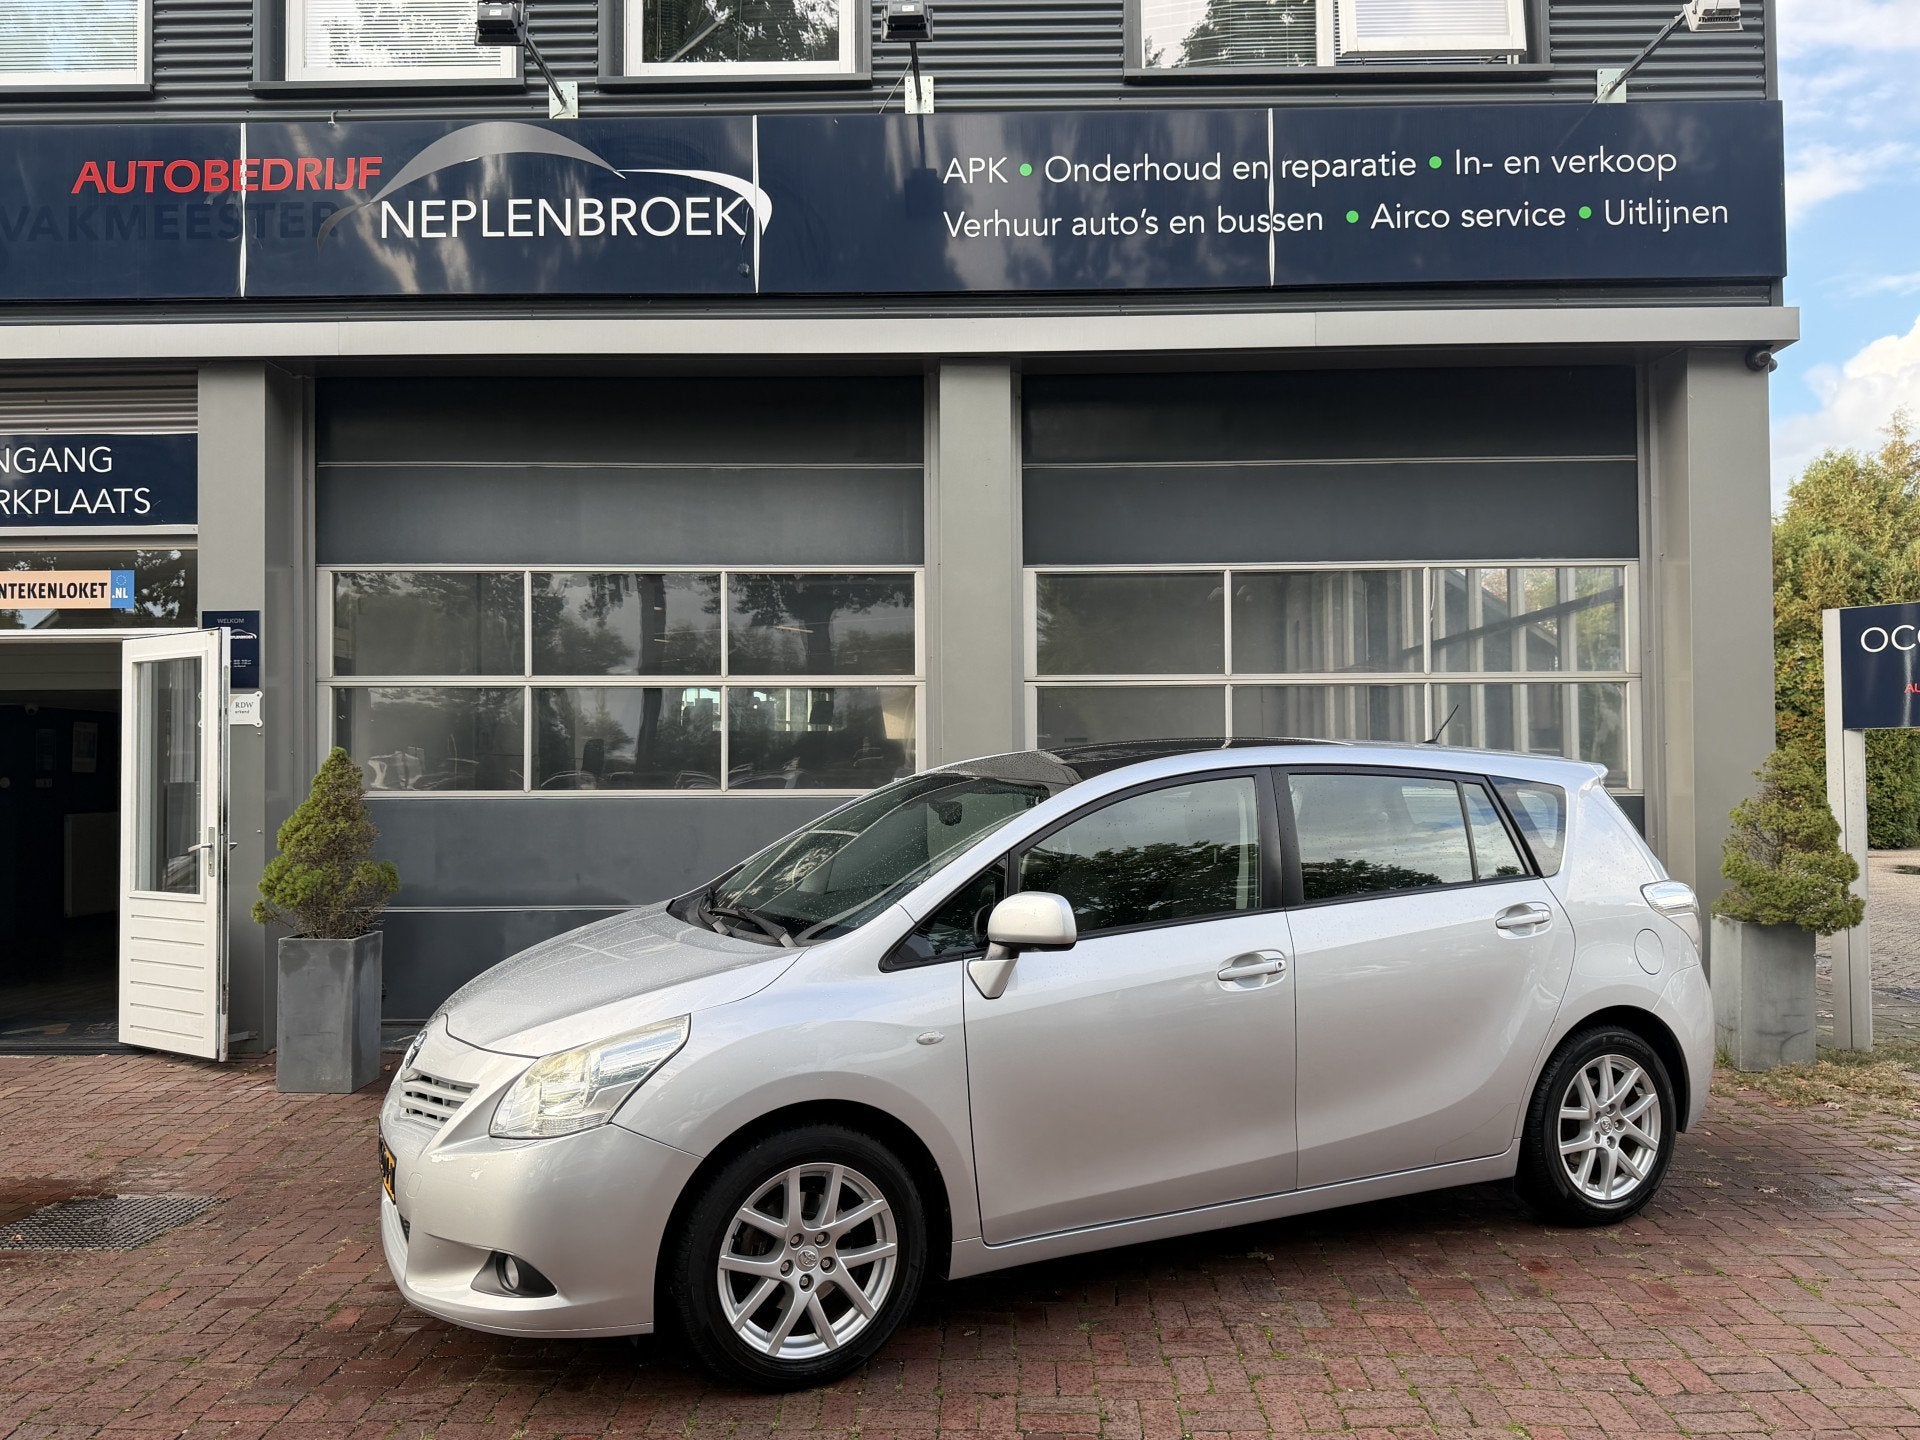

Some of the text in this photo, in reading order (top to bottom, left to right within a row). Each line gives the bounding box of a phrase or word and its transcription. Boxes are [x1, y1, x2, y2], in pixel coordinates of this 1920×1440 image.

[71, 155, 384, 195] AUTOBEDRIJF
[941, 144, 1678, 187] APK Onderhoud en reparatie In- en verkoop
[0, 201, 340, 243] VAKMEESTER
[379, 195, 747, 240] NEPLENBROEK
[942, 196, 1729, 239] Verhuur auto's en bussen Airco service Uitlijnen
[1859, 624, 1920, 653] OC
[235, 701, 254, 709] RDW
